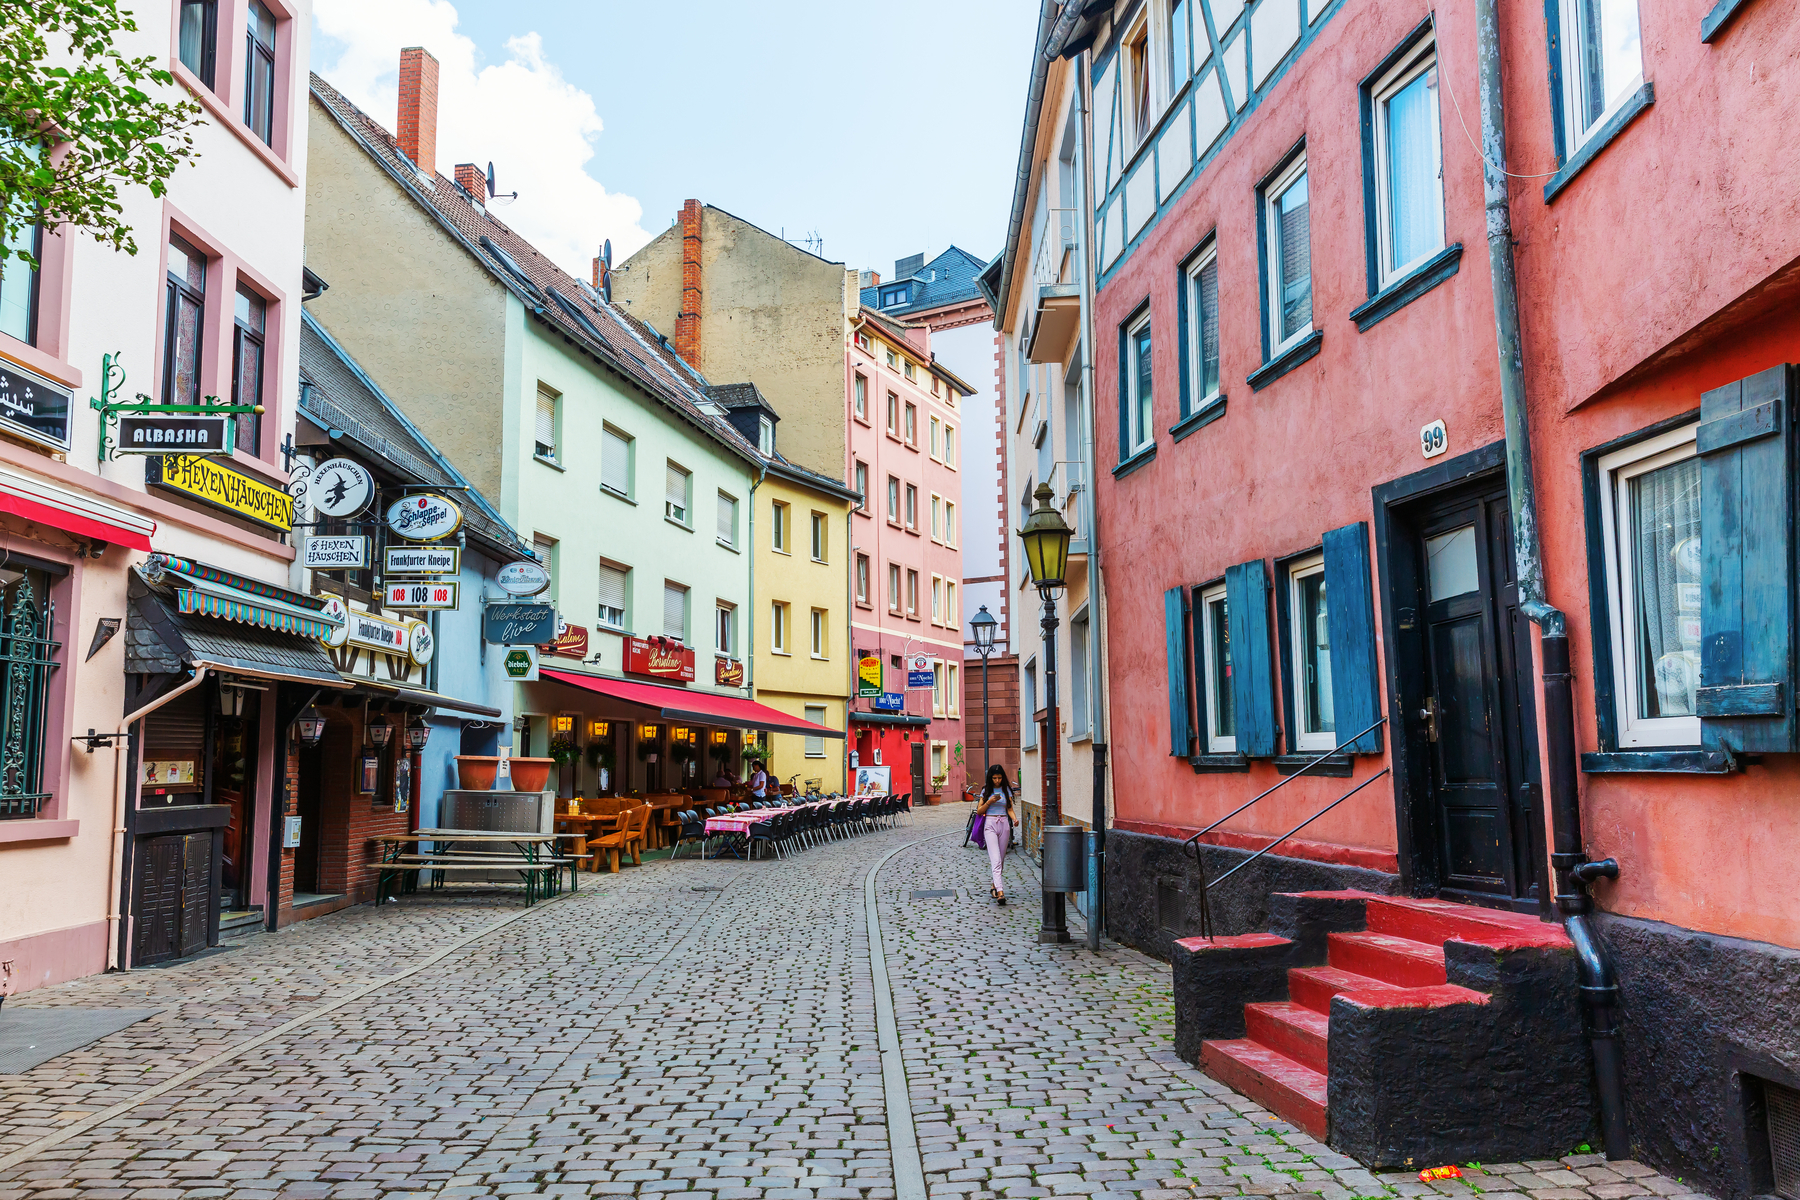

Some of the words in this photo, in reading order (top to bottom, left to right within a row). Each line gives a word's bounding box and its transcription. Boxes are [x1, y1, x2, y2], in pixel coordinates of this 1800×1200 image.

[133, 428, 208, 443] ALBASHA
[1423, 426, 1443, 452] 99
[314, 461, 363, 485] HEXENHÄUSCHEN
[181, 459, 294, 527] HEXENHÄUSCHEN
[320, 540, 355, 550] HEXEN
[390, 554, 426, 567] Frankfurter
[428, 554, 451, 567] Kneipe
[392, 588, 406, 602] 108
[411, 587, 428, 603] 108
[434, 589, 448, 602] 108
[491, 605, 549, 621] Werkstatt
[501, 622, 537, 642] live
[507, 660, 529, 669] Diebels
